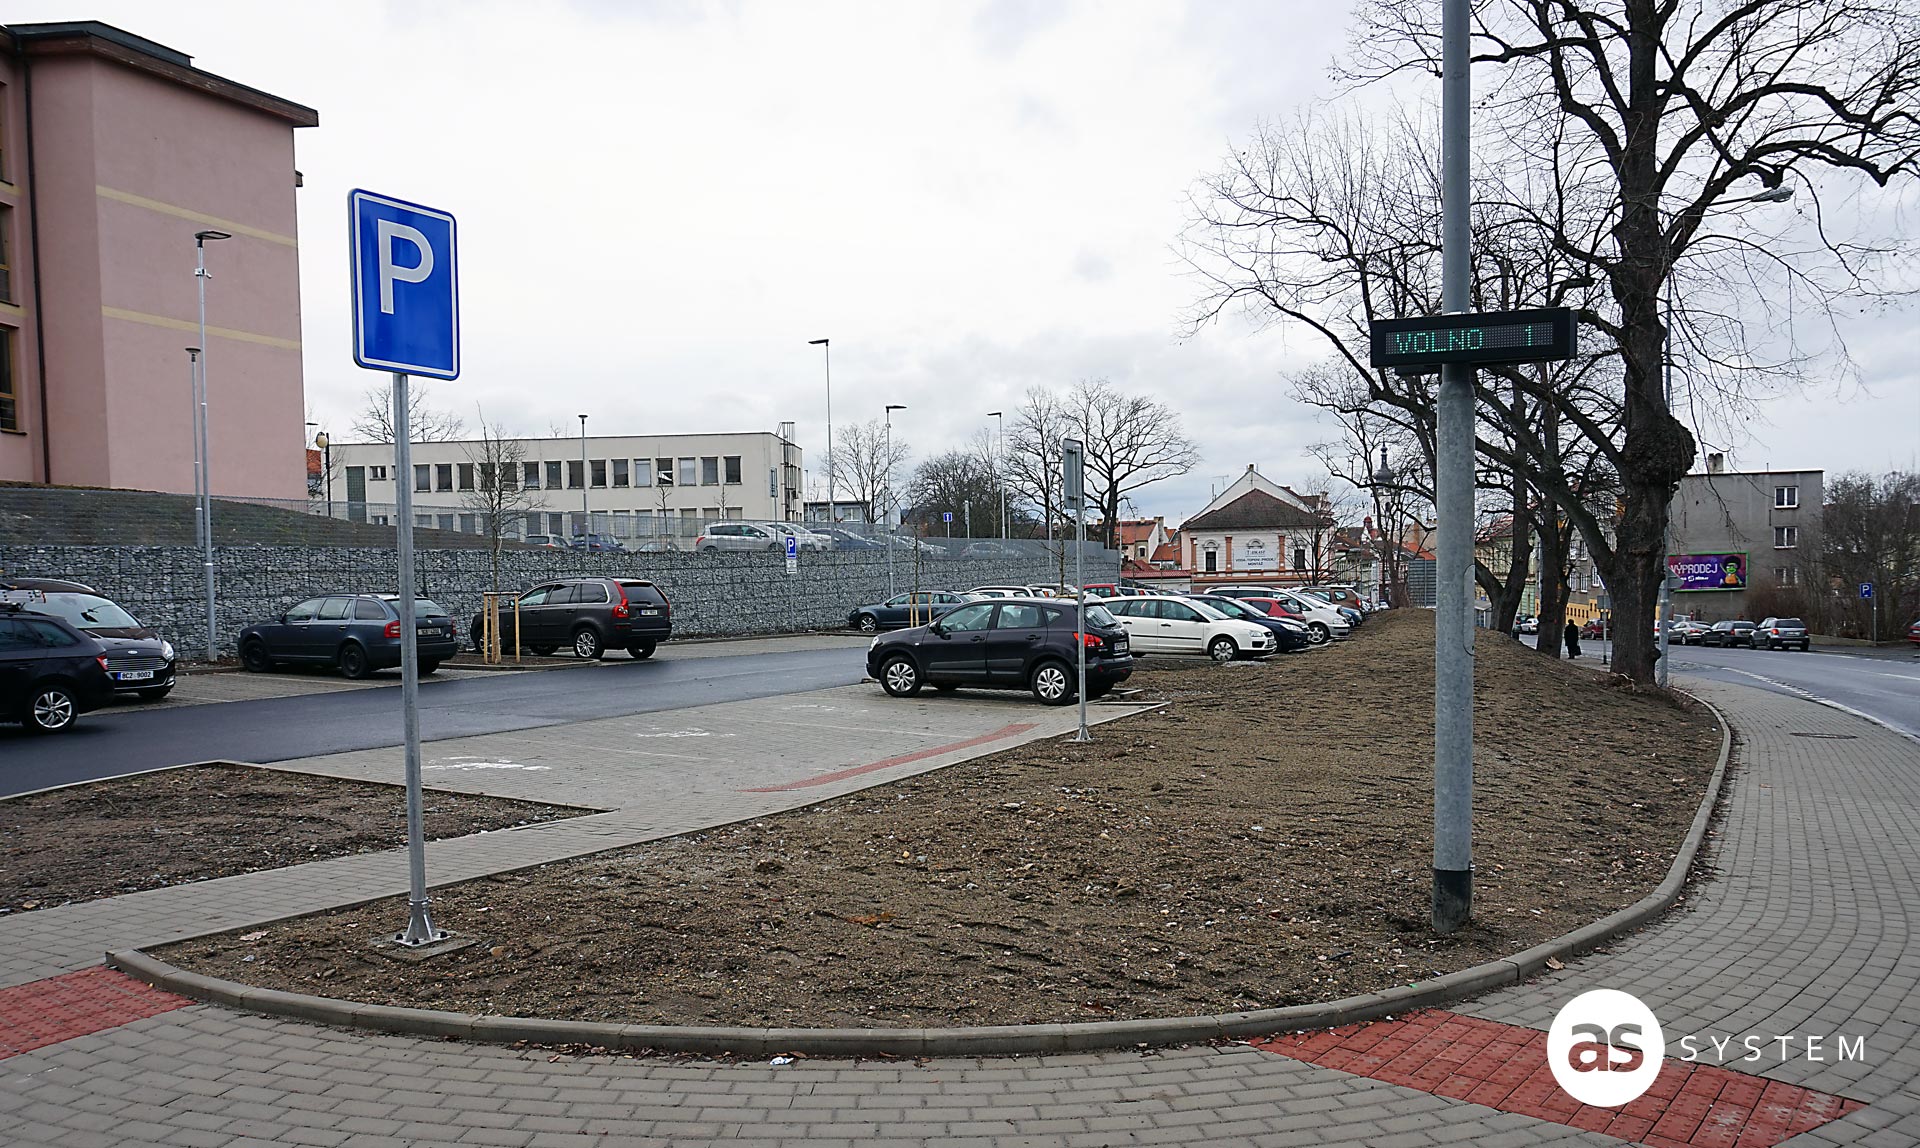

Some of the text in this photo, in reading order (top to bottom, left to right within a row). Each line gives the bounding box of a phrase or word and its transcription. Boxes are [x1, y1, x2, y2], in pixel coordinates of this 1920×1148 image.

[377, 219, 434, 315] P
[1396, 325, 1532, 354] VOLNO 1
[1670, 562, 1718, 574] VÝPRODEJ
[1862, 585, 1870, 594] P
